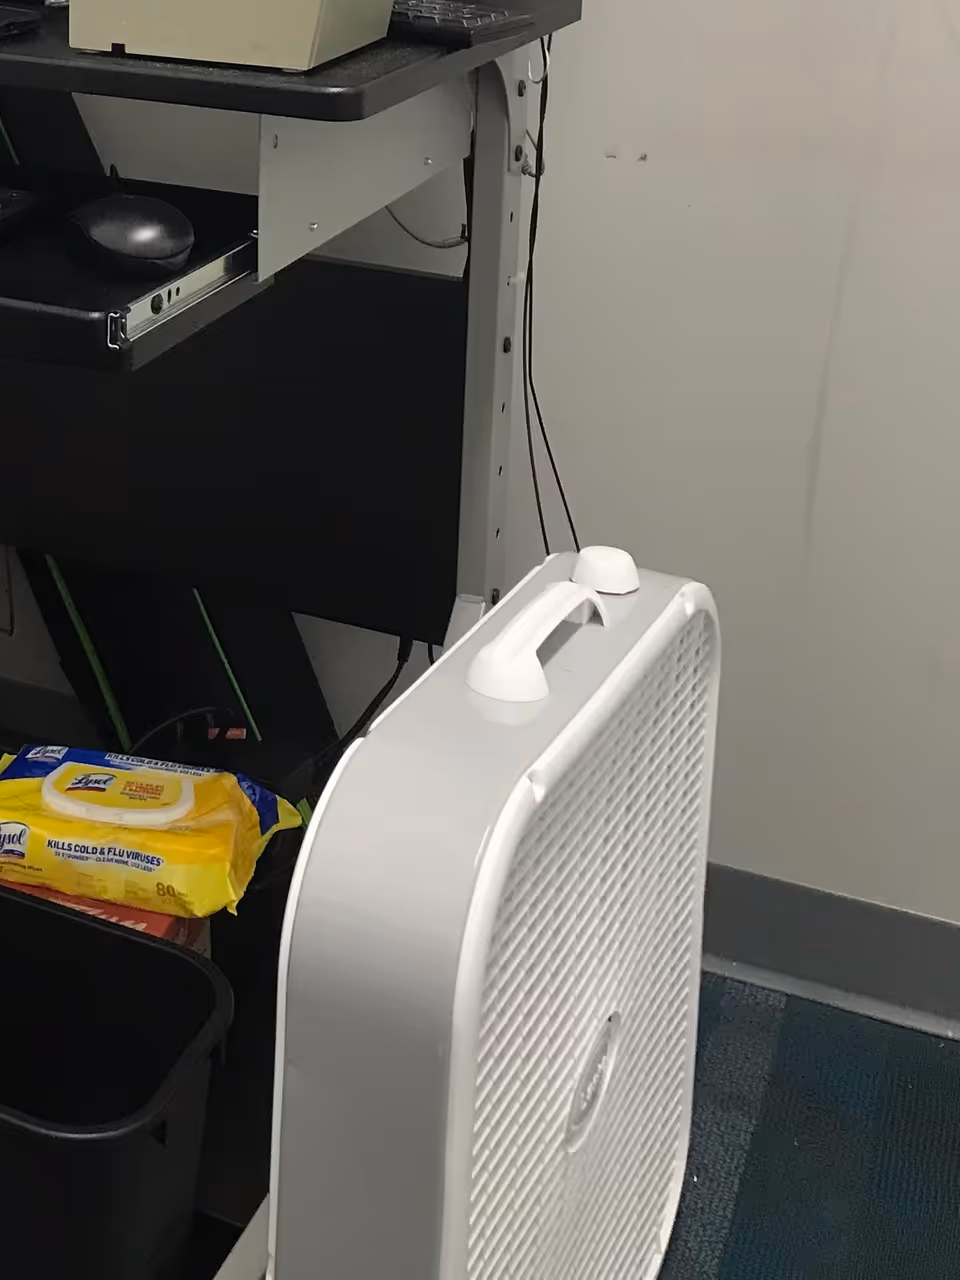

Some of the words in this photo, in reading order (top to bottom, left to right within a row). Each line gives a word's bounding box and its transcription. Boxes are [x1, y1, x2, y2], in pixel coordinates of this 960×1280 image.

[72, 774, 115, 788] Lysol
[47, 839, 72, 852] KILLS
[73, 844, 98, 855] COLD
[107, 847, 125, 858] FLU
